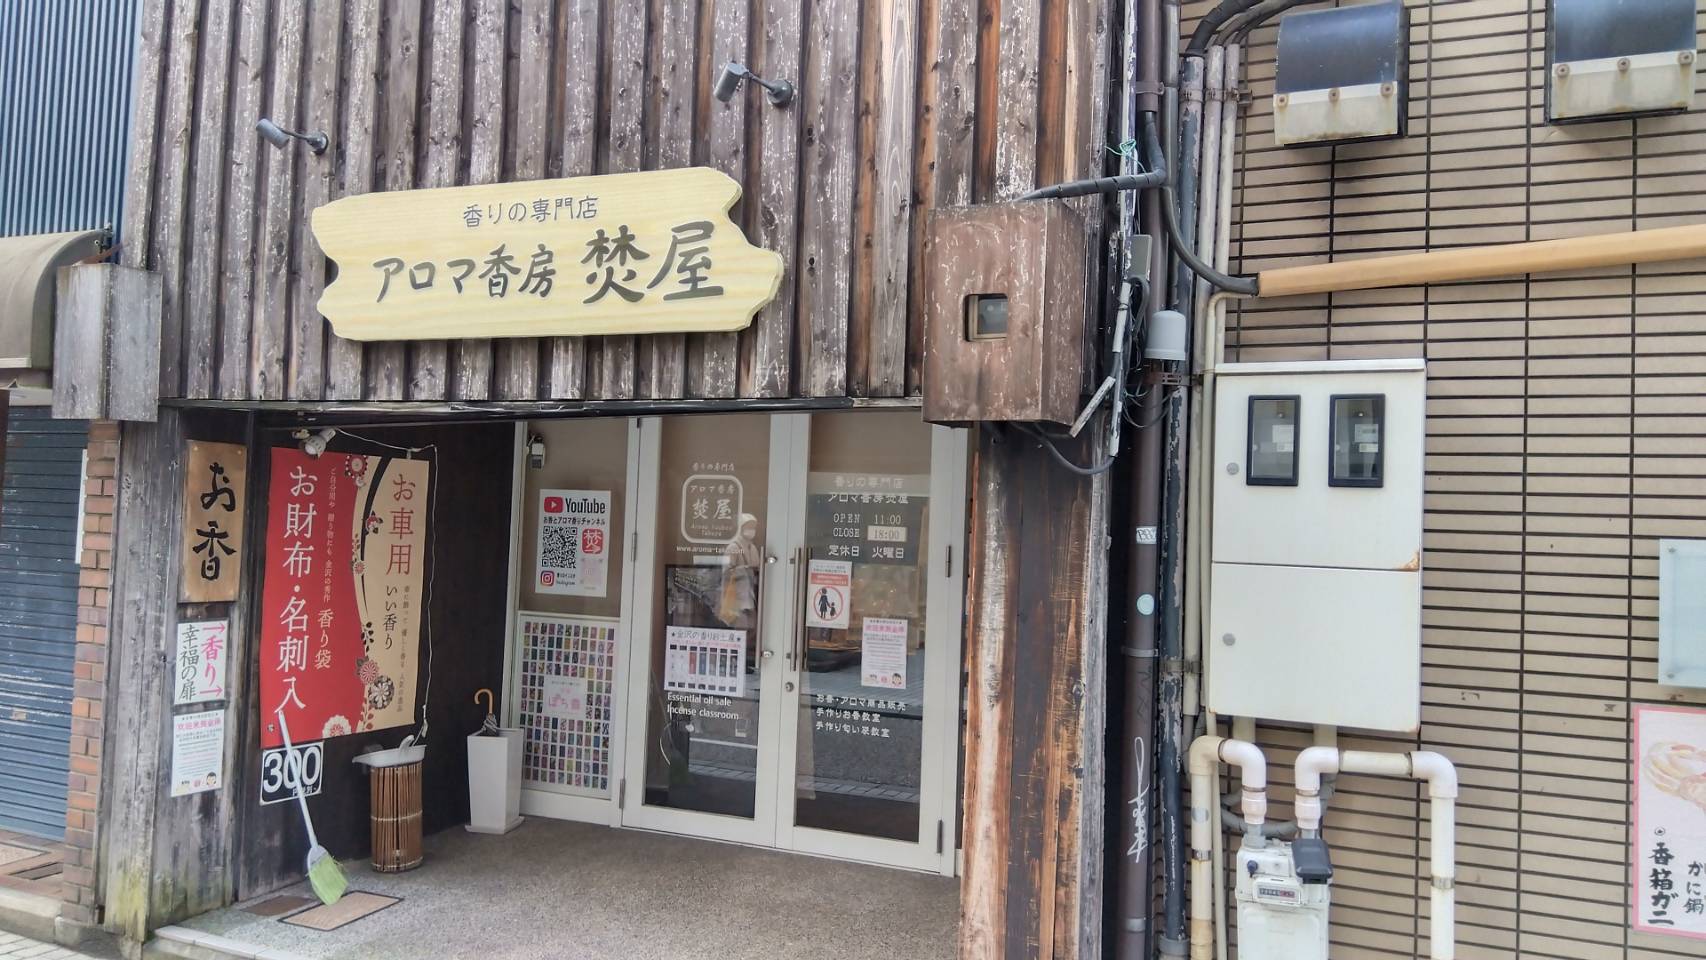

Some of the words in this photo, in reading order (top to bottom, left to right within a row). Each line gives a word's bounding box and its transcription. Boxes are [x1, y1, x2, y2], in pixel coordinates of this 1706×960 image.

[463, 195, 600, 228] 香りの専門店
[372, 242, 557, 304] アロマ香房
[580, 220, 725, 305] 焚屋
[193, 461, 238, 581] お香
[386, 474, 416, 575] お車用
[565, 498, 606, 514] YouTube
[692, 498, 732, 520] 焚屋
[833, 513, 860, 523] OPEN
[874, 514, 901, 525] 11:00
[828, 545, 860, 557] 定休日
[872, 546, 904, 558] 火曜日
[833, 527, 860, 538] CLOSE
[874, 529, 900, 540] 18:00
[275, 465, 319, 714] お財布・名刺入
[314, 608, 334, 669] 香り袋
[383, 585, 398, 650] いい香り
[179, 624, 200, 700] 幸福の扉
[201, 635, 224, 687] 香り
[667, 692, 702, 703] Essential
[703, 696, 714, 705] oil
[716, 697, 732, 706] sale
[667, 703, 697, 715] Incense
[699, 709, 739, 720] classroom
[263, 746, 321, 793] 300
[1648, 842, 1679, 925] 香箱ガニ
[1683, 861, 1705, 915] かに鍋
